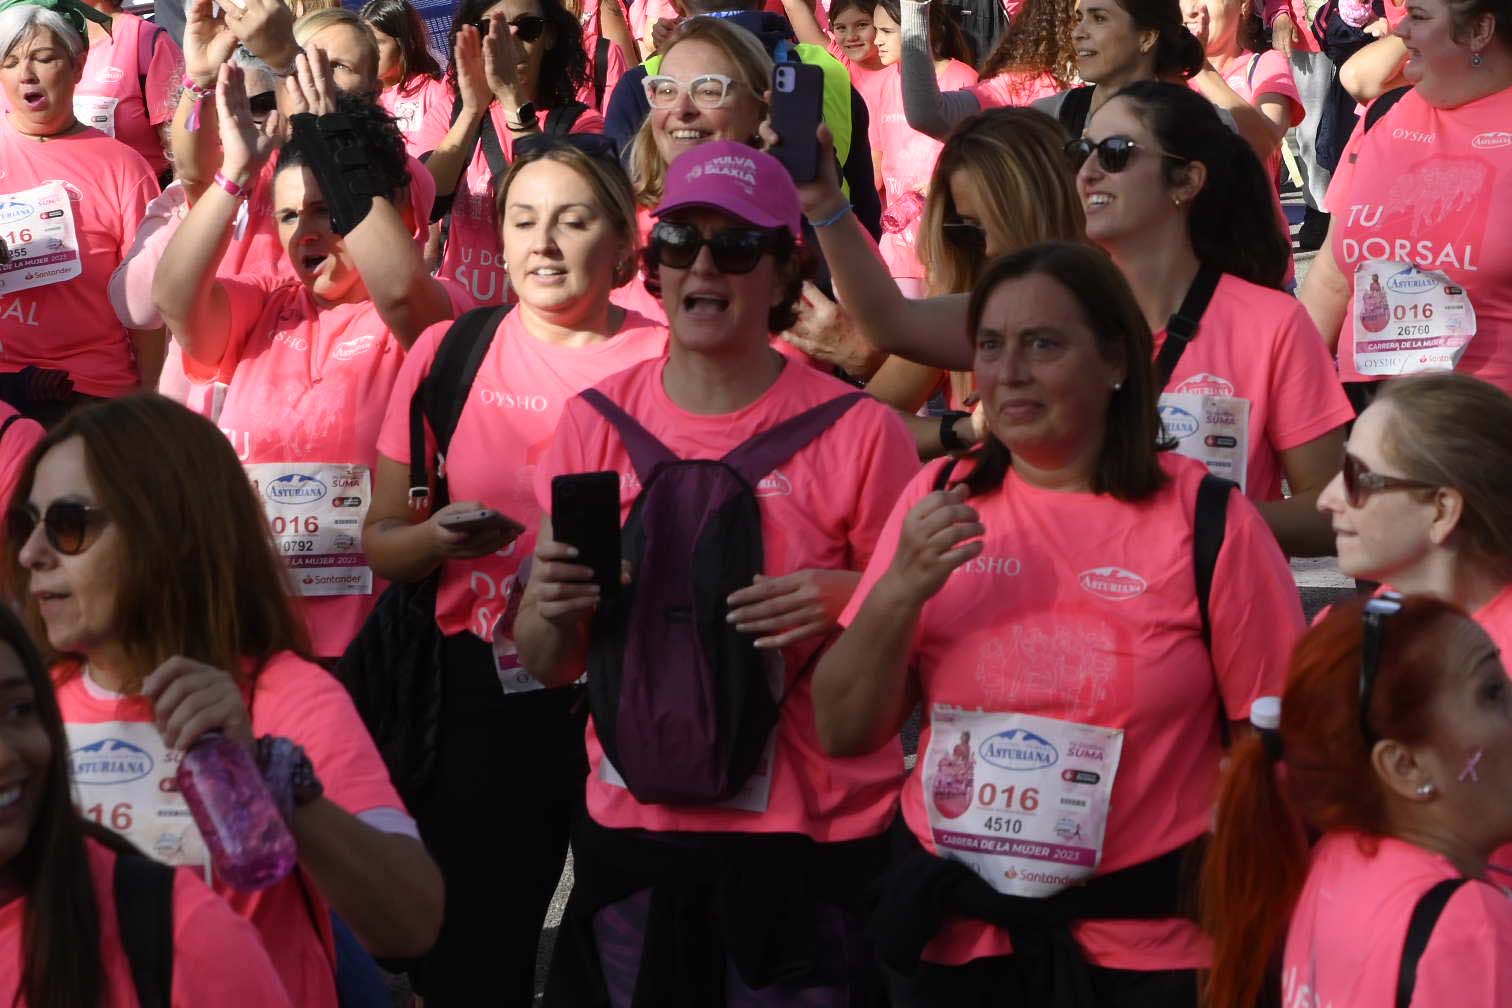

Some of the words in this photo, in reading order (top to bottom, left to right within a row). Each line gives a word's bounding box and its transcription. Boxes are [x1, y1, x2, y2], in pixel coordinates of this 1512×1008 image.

[1392, 128, 1436, 143] OYSHO
[1347, 203, 1384, 227] TU
[1343, 237, 1478, 271] DORSAL
[1393, 302, 1433, 321] 016
[1397, 324, 1430, 336] 26760
[1412, 340, 1422, 348] LA
[480, 389, 548, 412] OYSHO
[332, 479, 360, 488] SUMA
[272, 515, 320, 534] 016
[314, 575, 362, 586] Santander
[984, 743, 1051, 763] ASTURIANA
[1067, 747, 1104, 761] SUMA
[978, 782, 1040, 812] 016
[984, 815, 1023, 834] 4510
[980, 839, 993, 850] DE
[997, 840, 1012, 852] LA
[1012, 843, 1051, 857] MUJER
